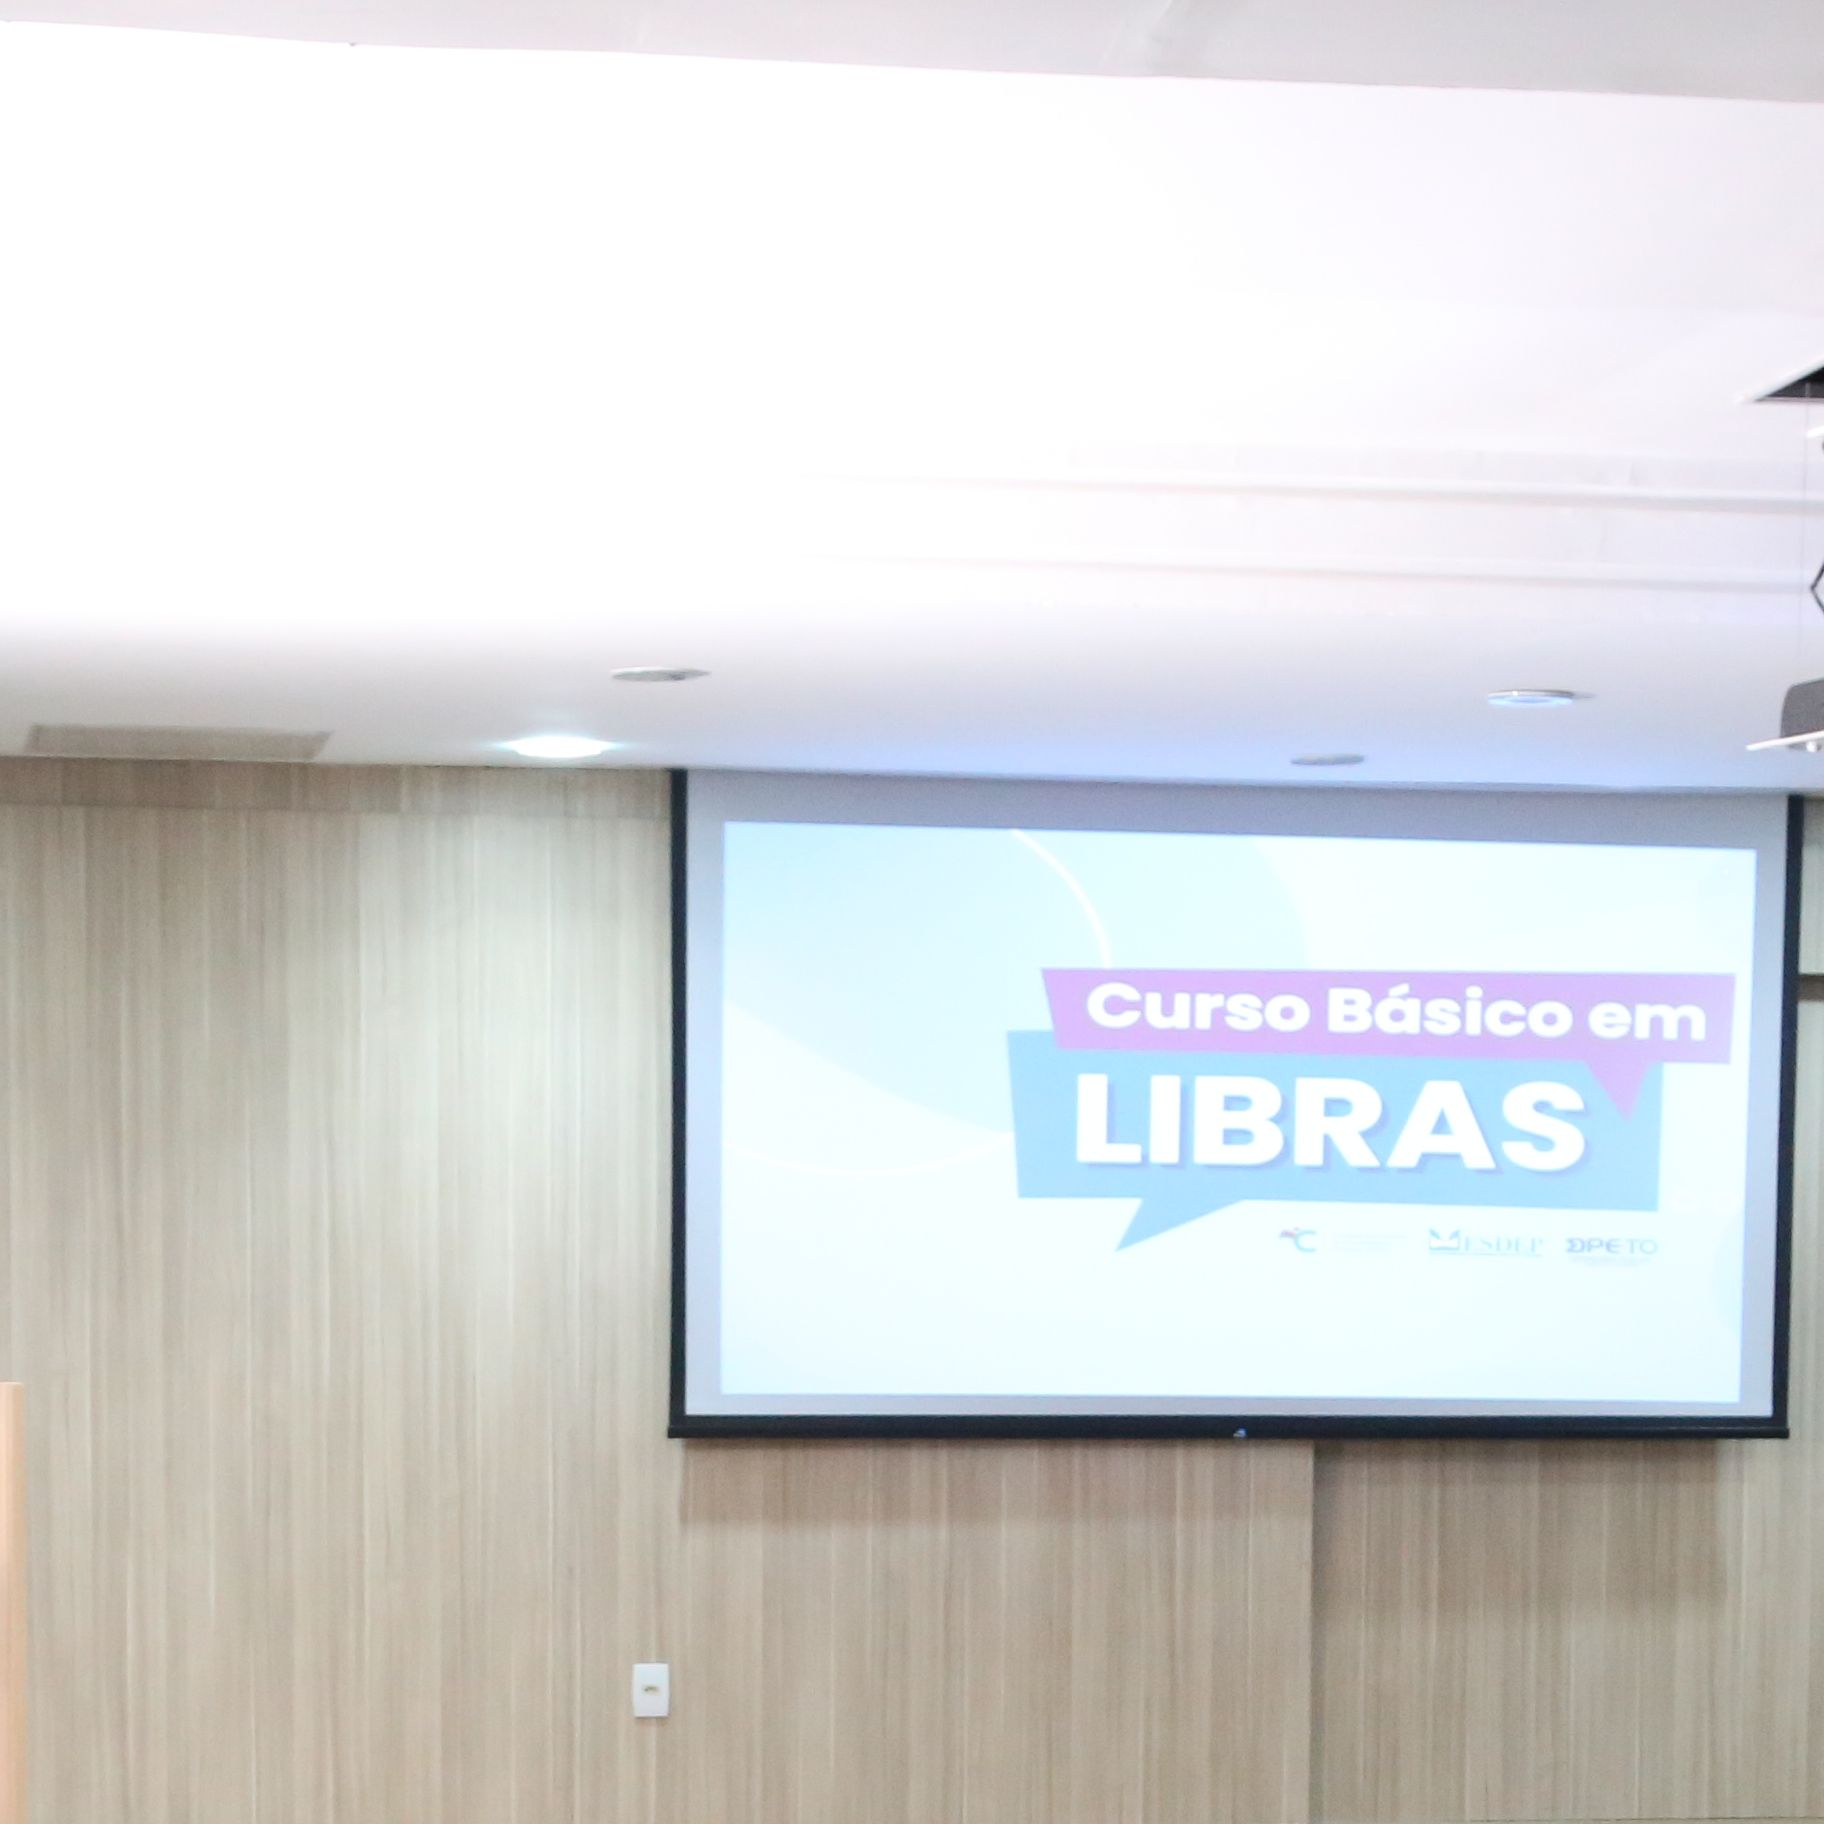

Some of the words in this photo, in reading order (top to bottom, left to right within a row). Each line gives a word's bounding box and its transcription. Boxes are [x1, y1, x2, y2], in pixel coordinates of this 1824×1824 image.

[1087, 982, 1310, 1032] Curso
[1328, 983, 1573, 1039] Básico
[1589, 1001, 1707, 1041] em
[1076, 1073, 1588, 1172] LIBRAS
